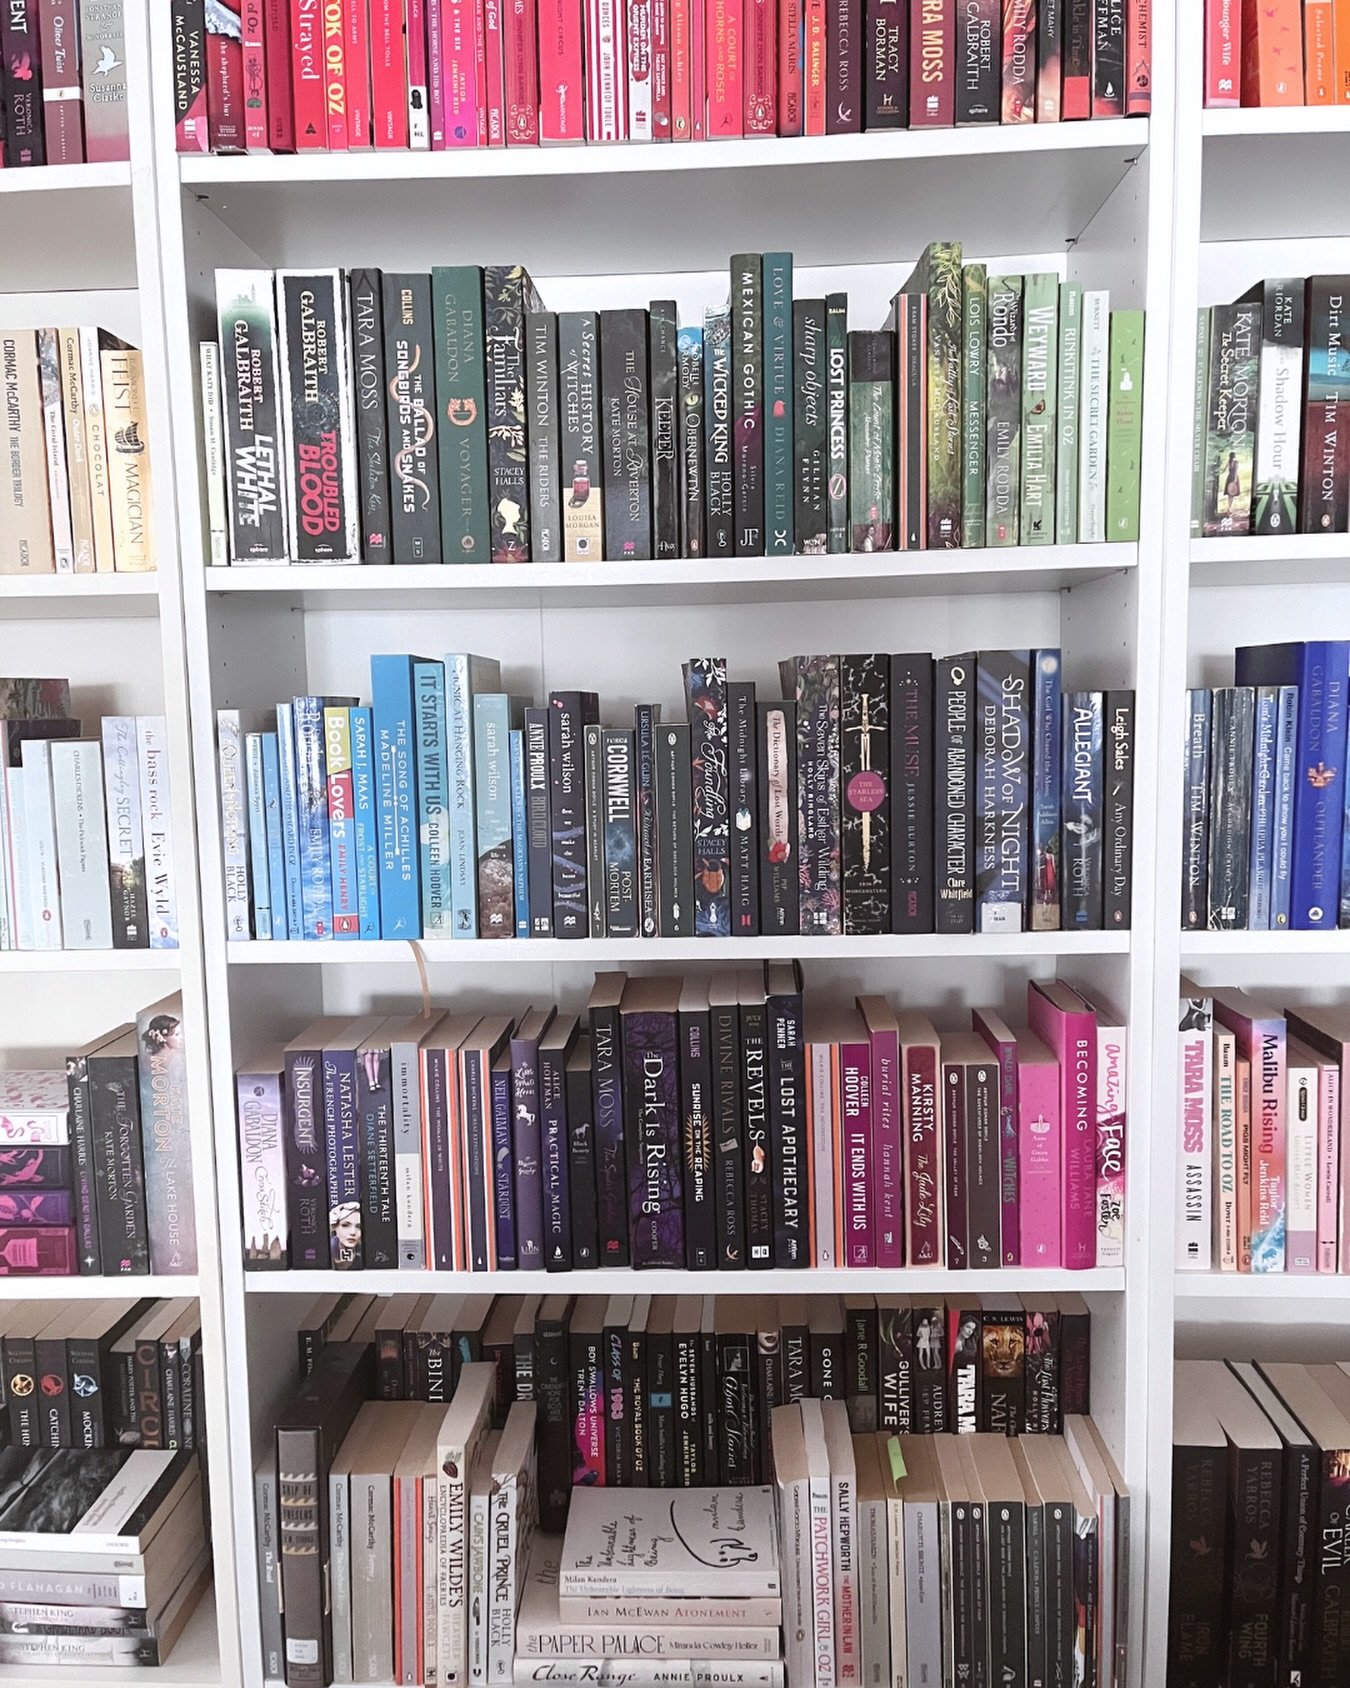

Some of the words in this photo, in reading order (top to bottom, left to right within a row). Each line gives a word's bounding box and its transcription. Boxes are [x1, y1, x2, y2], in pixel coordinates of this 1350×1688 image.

[295, 0, 320, 80] Strayed
[812, 16, 819, 24] J.
[812, 27, 819, 35] D.
[839, 0, 848, 55] REBECCA
[55, 49, 66, 73] Twist
[175, 16, 187, 110] McCAUSLAND
[189, 31, 200, 94] VANESSA
[811, 41, 820, 86] SALINGER
[876, 18, 886, 81] BORMAN
[888, 26, 899, 73] TRACY
[967, 2, 979, 90] GALBRAITH
[980, 20, 991, 72] ROBERT
[220, 57, 230, 100] shepherd's
[840, 61, 849, 91] ROSS
[356, 292, 374, 346] TARA
[742, 272, 754, 353] MEXICAN
[1328, 295, 1342, 328] Dirt
[3, 340, 18, 379] CORMAC
[300, 291, 318, 403] GALBRAITH
[316, 320, 328, 375] ROBERT
[535, 325, 547, 355] TIM
[800, 317, 822, 366] sharp
[1028, 306, 1054, 391] WEYWARD
[1326, 333, 1341, 376] Music
[234, 320, 253, 431] GALBRAITH
[251, 349, 263, 403] ROBERT
[359, 354, 377, 410] MOSS
[396, 340, 410, 424] SONGBIRDS
[413, 374, 423, 393] THE
[713, 359, 728, 420] WICKED
[830, 348, 844, 386] LOST
[6, 382, 21, 432] McCARTHY
[536, 360, 549, 426] WINTON
[743, 364, 755, 429] GOTHIC
[804, 371, 822, 427] objects
[1324, 391, 1339, 423] TIM
[402, 429, 411, 449] AND
[413, 398, 426, 457] BALLAD
[538, 435, 549, 459] THE
[710, 423, 728, 463] KING
[830, 390, 844, 460] PRINCESS
[1025, 424, 1048, 469] EMILIA
[235, 446, 259, 527] WHITE
[254, 435, 276, 515] LETHAL
[320, 431, 340, 531] TROUBLED
[401, 454, 415, 513] SNAKES
[417, 461, 426, 475] OF
[538, 464, 550, 508] RIDERS
[812, 450, 820, 511] GILLIAN
[1322, 431, 1338, 501] WINTON
[299, 443, 323, 536] BLOOD
[710, 471, 720, 516] BLACK
[721, 471, 732, 516] HOLLY
[1025, 475, 1046, 507] HART
[420, 675, 436, 689] IT
[421, 695, 439, 747] STARTS
[738, 696, 747, 715] The
[1112, 708, 1129, 740] Leigh
[145, 730, 155, 746] the
[328, 716, 344, 768] Book
[355, 717, 366, 758] SARAH
[397, 720, 406, 745] THE
[737, 719, 749, 765] Midnight
[984, 705, 995, 779] DEBORAH
[1000, 674, 1024, 784] SHADOW
[146, 749, 161, 785] bass
[357, 762, 367, 770] J.
[381, 730, 392, 807] MADELINE
[398, 751, 408, 789] SONG
[423, 752, 440, 791] WITH
[1072, 707, 1092, 804] ALLEGIANT
[1115, 742, 1128, 770] Sales
[149, 789, 162, 820] rock
[330, 773, 347, 838] Lovers
[358, 775, 368, 809] MAAS
[400, 794, 409, 811] OF
[425, 795, 441, 815] US
[607, 744, 630, 823] CORNWELL
[739, 767, 749, 805] Library
[1002, 784, 1013, 803] OF
[984, 787, 995, 869] HARKNESS
[1112, 803, 1125, 823] Any
[151, 832, 167, 866] Evie
[338, 844, 348, 875] EMILY
[384, 815, 394, 870] MILLER
[400, 816, 411, 881] ACHILLES
[428, 823, 440, 866] COLLEEN
[740, 835, 749, 868] MATT
[1002, 803, 1023, 891] NIGHT
[1112, 826, 1127, 873] Ordinary
[151, 873, 170, 914] Wyld
[340, 878, 348, 910] HENRY
[430, 869, 441, 909] HOOVER
[741, 874, 750, 906] HAIG
[1111, 876, 1125, 897] Day
[776, 1018, 786, 1049] PENNER
[786, 1020, 795, 1047] SARAH
[643, 1057, 665, 1115] Dark
[1076, 1040, 1088, 1131] BECOMING
[1184, 1040, 1204, 1095] TARA
[1262, 1034, 1278, 1094] Malibu
[339, 1072, 352, 1140] NATASHA
[746, 1049, 765, 1141] REVELS
[780, 1077, 795, 1117] LOST
[845, 1067, 859, 1116] HOOVER
[861, 1075, 869, 1107] COLLEEN
[645, 1123, 660, 1137] Is
[851, 1133, 865, 1144] IT
[1183, 1097, 1204, 1154] MOSS
[1260, 1099, 1277, 1154] Rising
[342, 1146, 355, 1196] LESTER
[548, 1120, 559, 1189] PRACTICAL
[852, 1147, 865, 1178] ENDS
[1101, 1124, 1123, 1182] Face
[642, 1143, 667, 1214] Rising
[782, 1124, 798, 1228] APOTHECARY
[853, 1181, 866, 1213] WITH
[1185, 1165, 1202, 1222] ASSASSIN
[551, 1193, 561, 1233] MAGIC
[853, 1215, 867, 1230] US
[1099, 1194, 1112, 1231] Foster
[1111, 1200, 1121, 1221] Zoe
[588, 1346, 596, 1364] BOY
[679, 1343, 688, 1384] EVELYN
[577, 1369, 585, 1397] TRENT
[588, 1366, 596, 1413] SWALLOWS
[680, 1387, 689, 1419] HUGO
[884, 1373, 897, 1426] WIFE
[590, 1416, 598, 1457] UNIVERSE
[449, 1483, 464, 1533] EMILY
[839, 1482, 850, 1513] SALLY
[496, 1513, 510, 1553] CRUEL
[840, 1516, 851, 1571] HEPWORTH
[1321, 1528, 1342, 1575] EVIL
[449, 1538, 464, 1608] WILDE'S
[491, 1555, 511, 1602] PRINCE
[491, 1608, 501, 1647] BLACK
[501, 1608, 512, 1647] HOLLY
[588, 1608, 609, 1617] IAN
[675, 1609, 747, 1618] ATONEMENT
[539, 1635, 596, 1653] PAPER
[602, 1635, 665, 1653] PALACE
[654, 1673, 690, 1681] ANNIE
[697, 1673, 744, 1681] PROULX
